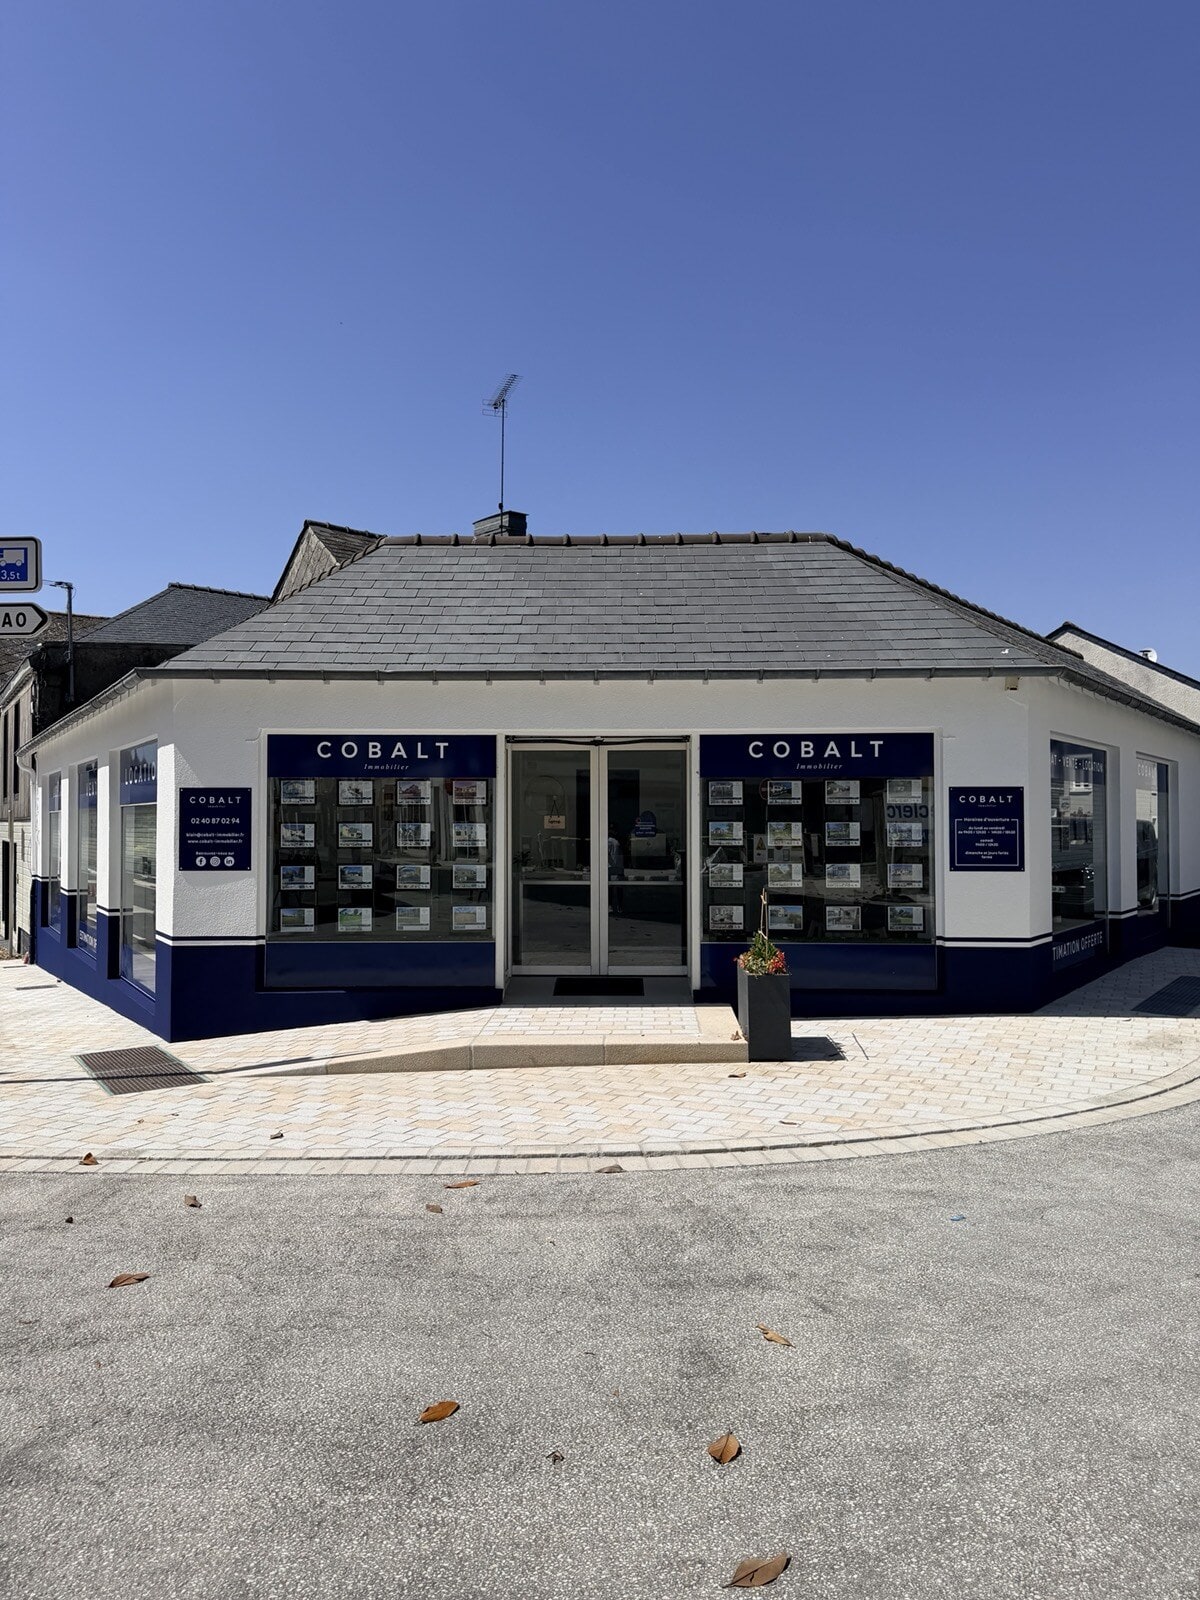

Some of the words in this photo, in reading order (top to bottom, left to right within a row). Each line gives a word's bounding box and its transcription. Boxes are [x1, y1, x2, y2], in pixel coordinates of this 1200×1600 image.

[317, 741, 449, 759] COBALT
[748, 740, 884, 758] COBALT
[189, 796, 242, 804] COBALT
[959, 795, 1013, 803] COBALT
